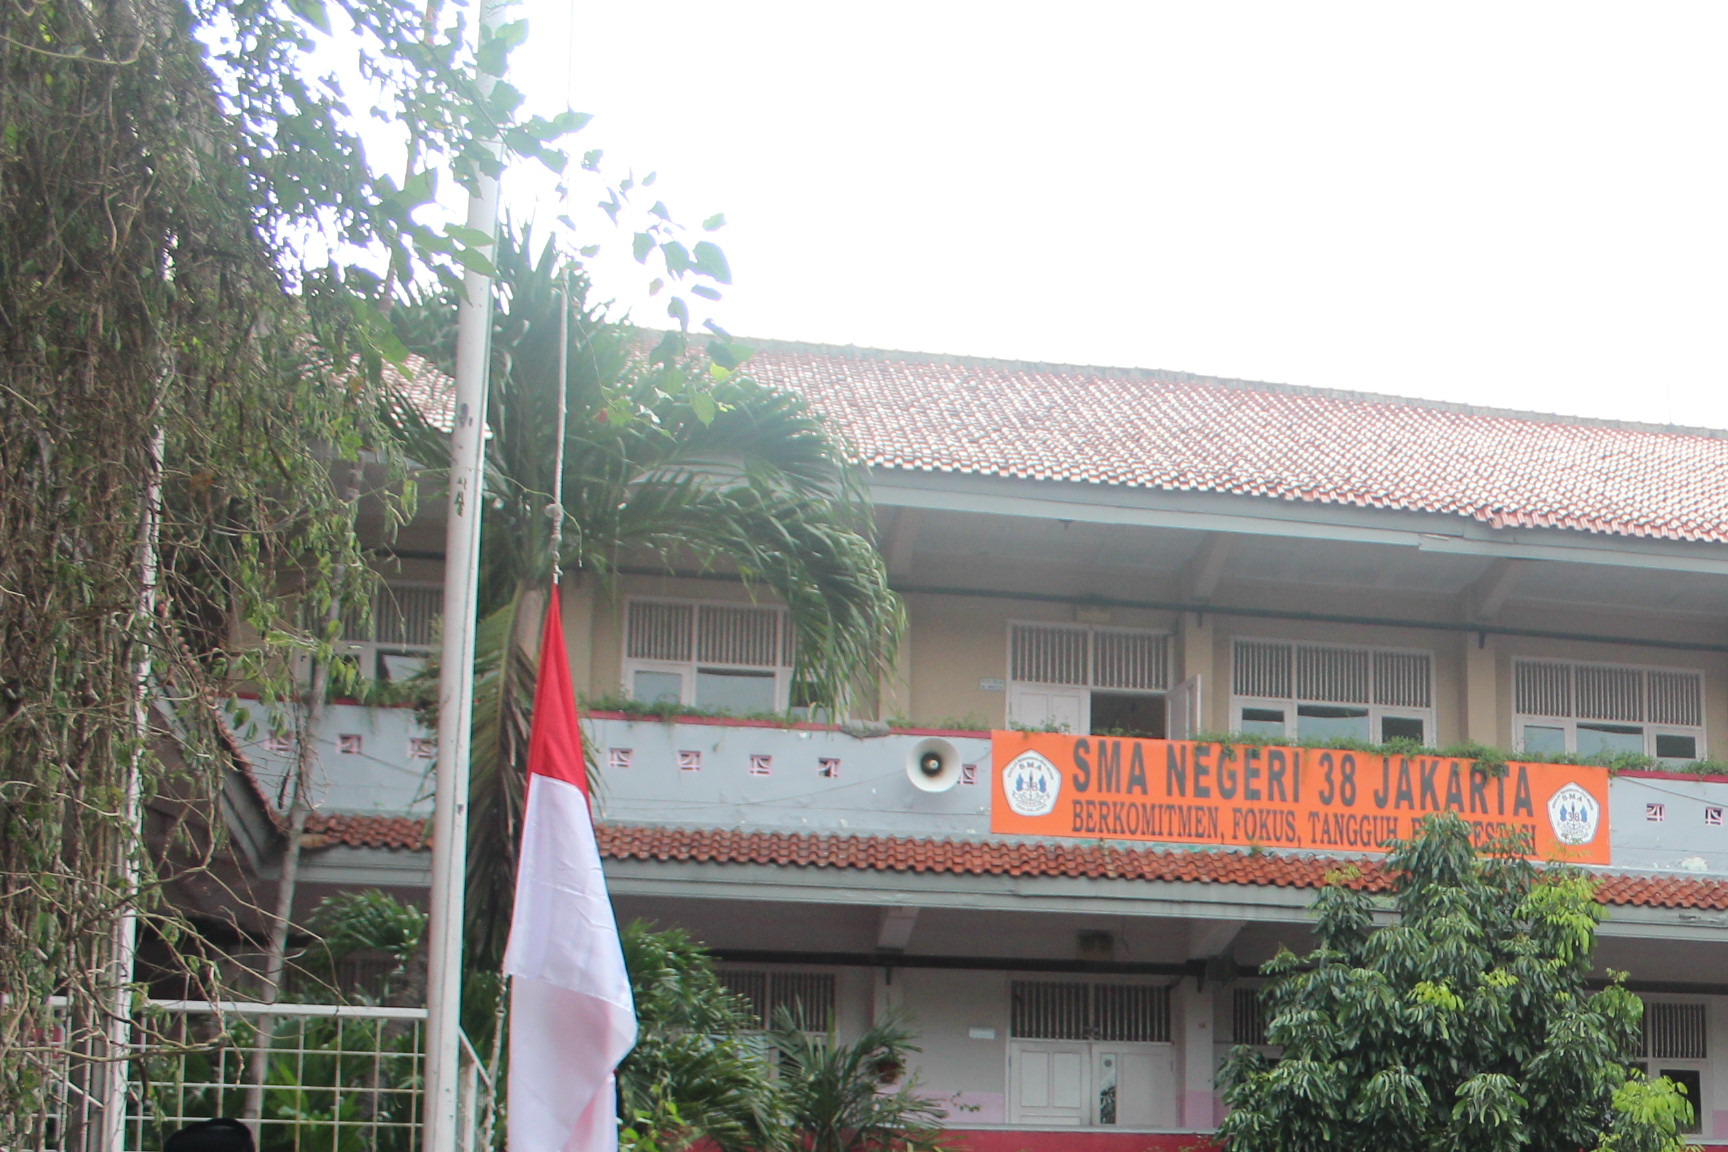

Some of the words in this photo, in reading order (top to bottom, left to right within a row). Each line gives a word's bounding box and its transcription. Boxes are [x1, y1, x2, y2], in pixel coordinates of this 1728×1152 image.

[1072, 738, 1148, 796] SMA
[1166, 744, 1300, 803] NEGERI
[1318, 752, 1356, 807] 38
[1372, 757, 1534, 818] JAKARTA
[1072, 799, 1224, 844] BERKOMITMEN,
[1231, 808, 1301, 847] FOKUS,
